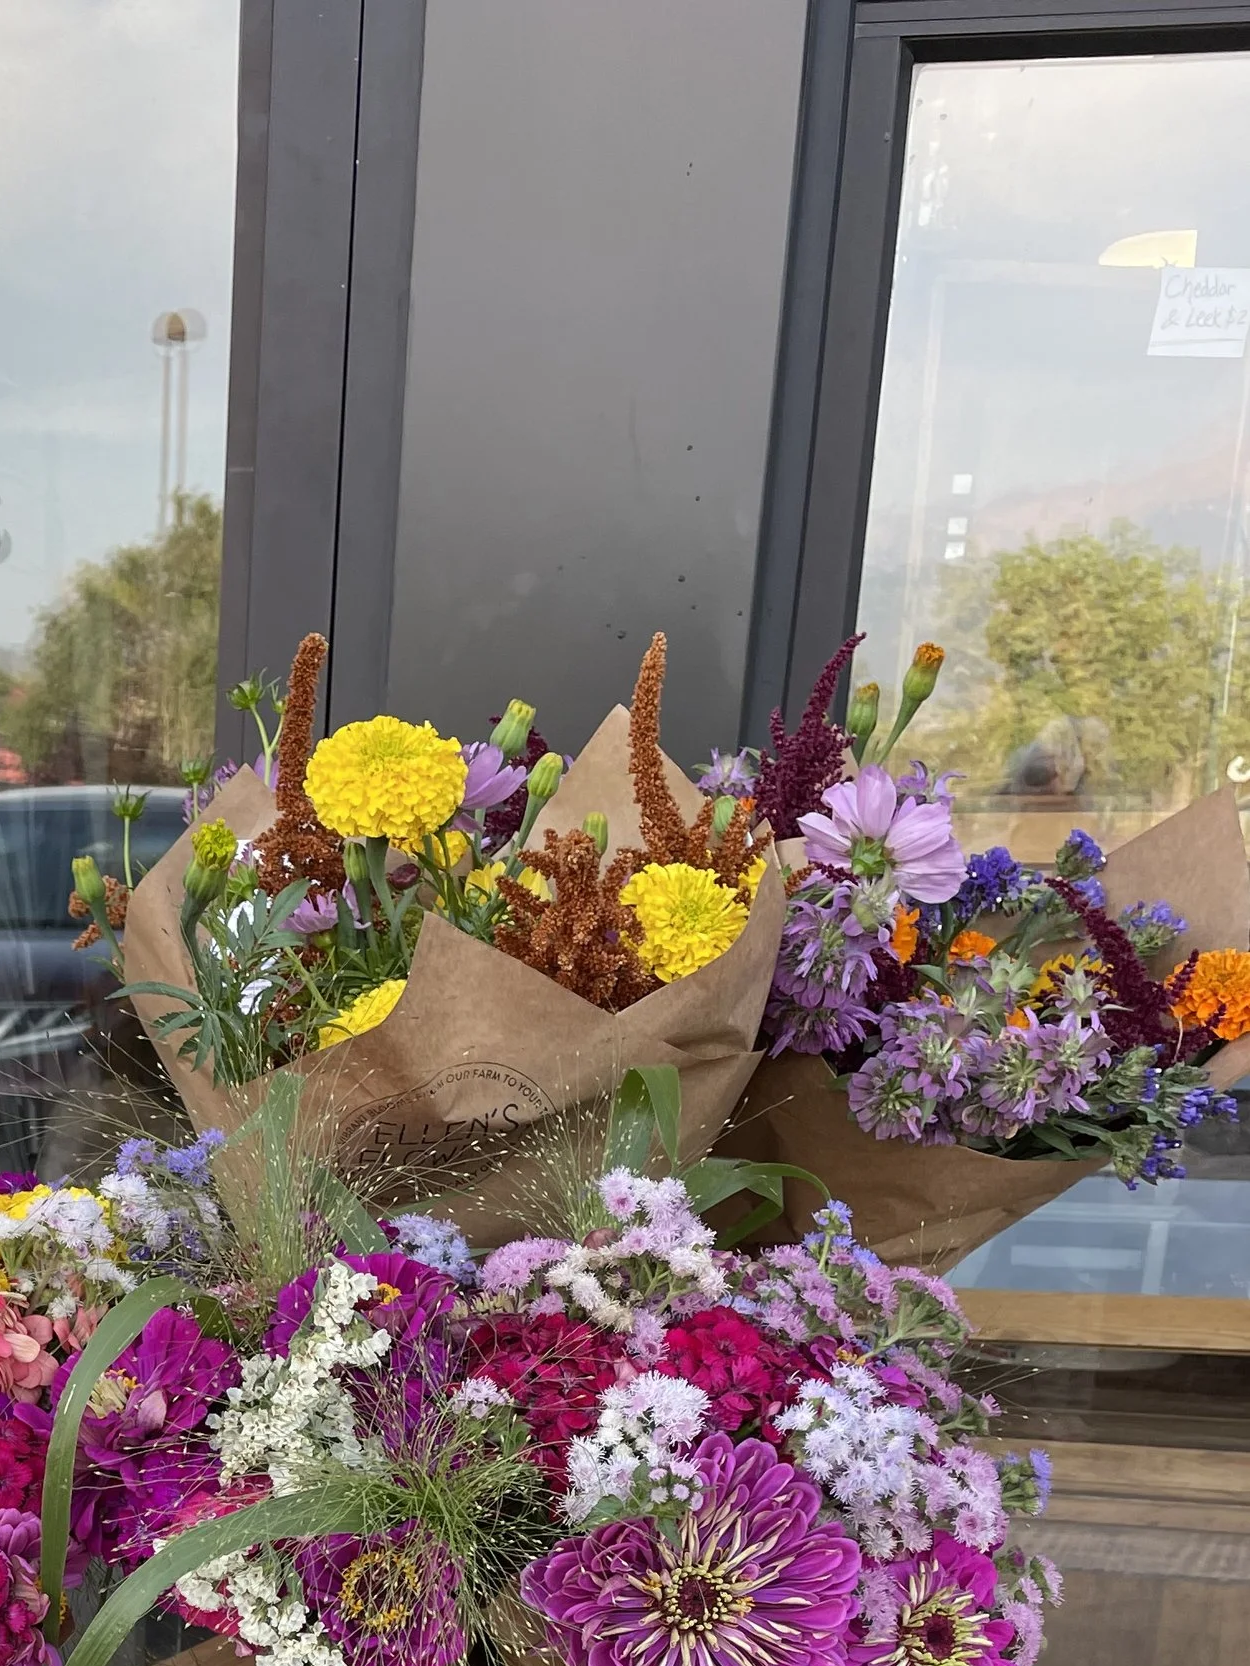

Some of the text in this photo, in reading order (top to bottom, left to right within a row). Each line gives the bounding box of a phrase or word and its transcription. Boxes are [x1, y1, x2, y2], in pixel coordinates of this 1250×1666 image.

[1165, 274, 1236, 304] Cheddar
[1161, 308, 1180, 330] &
[1185, 306, 1222, 328] Leek
[445, 1070, 470, 1084] OUR
[472, 1068, 500, 1081] FARM
[503, 1073, 517, 1087] TO
[517, 1082, 543, 1109] YOUR
[374, 1103, 519, 1145] ELLEN'S
